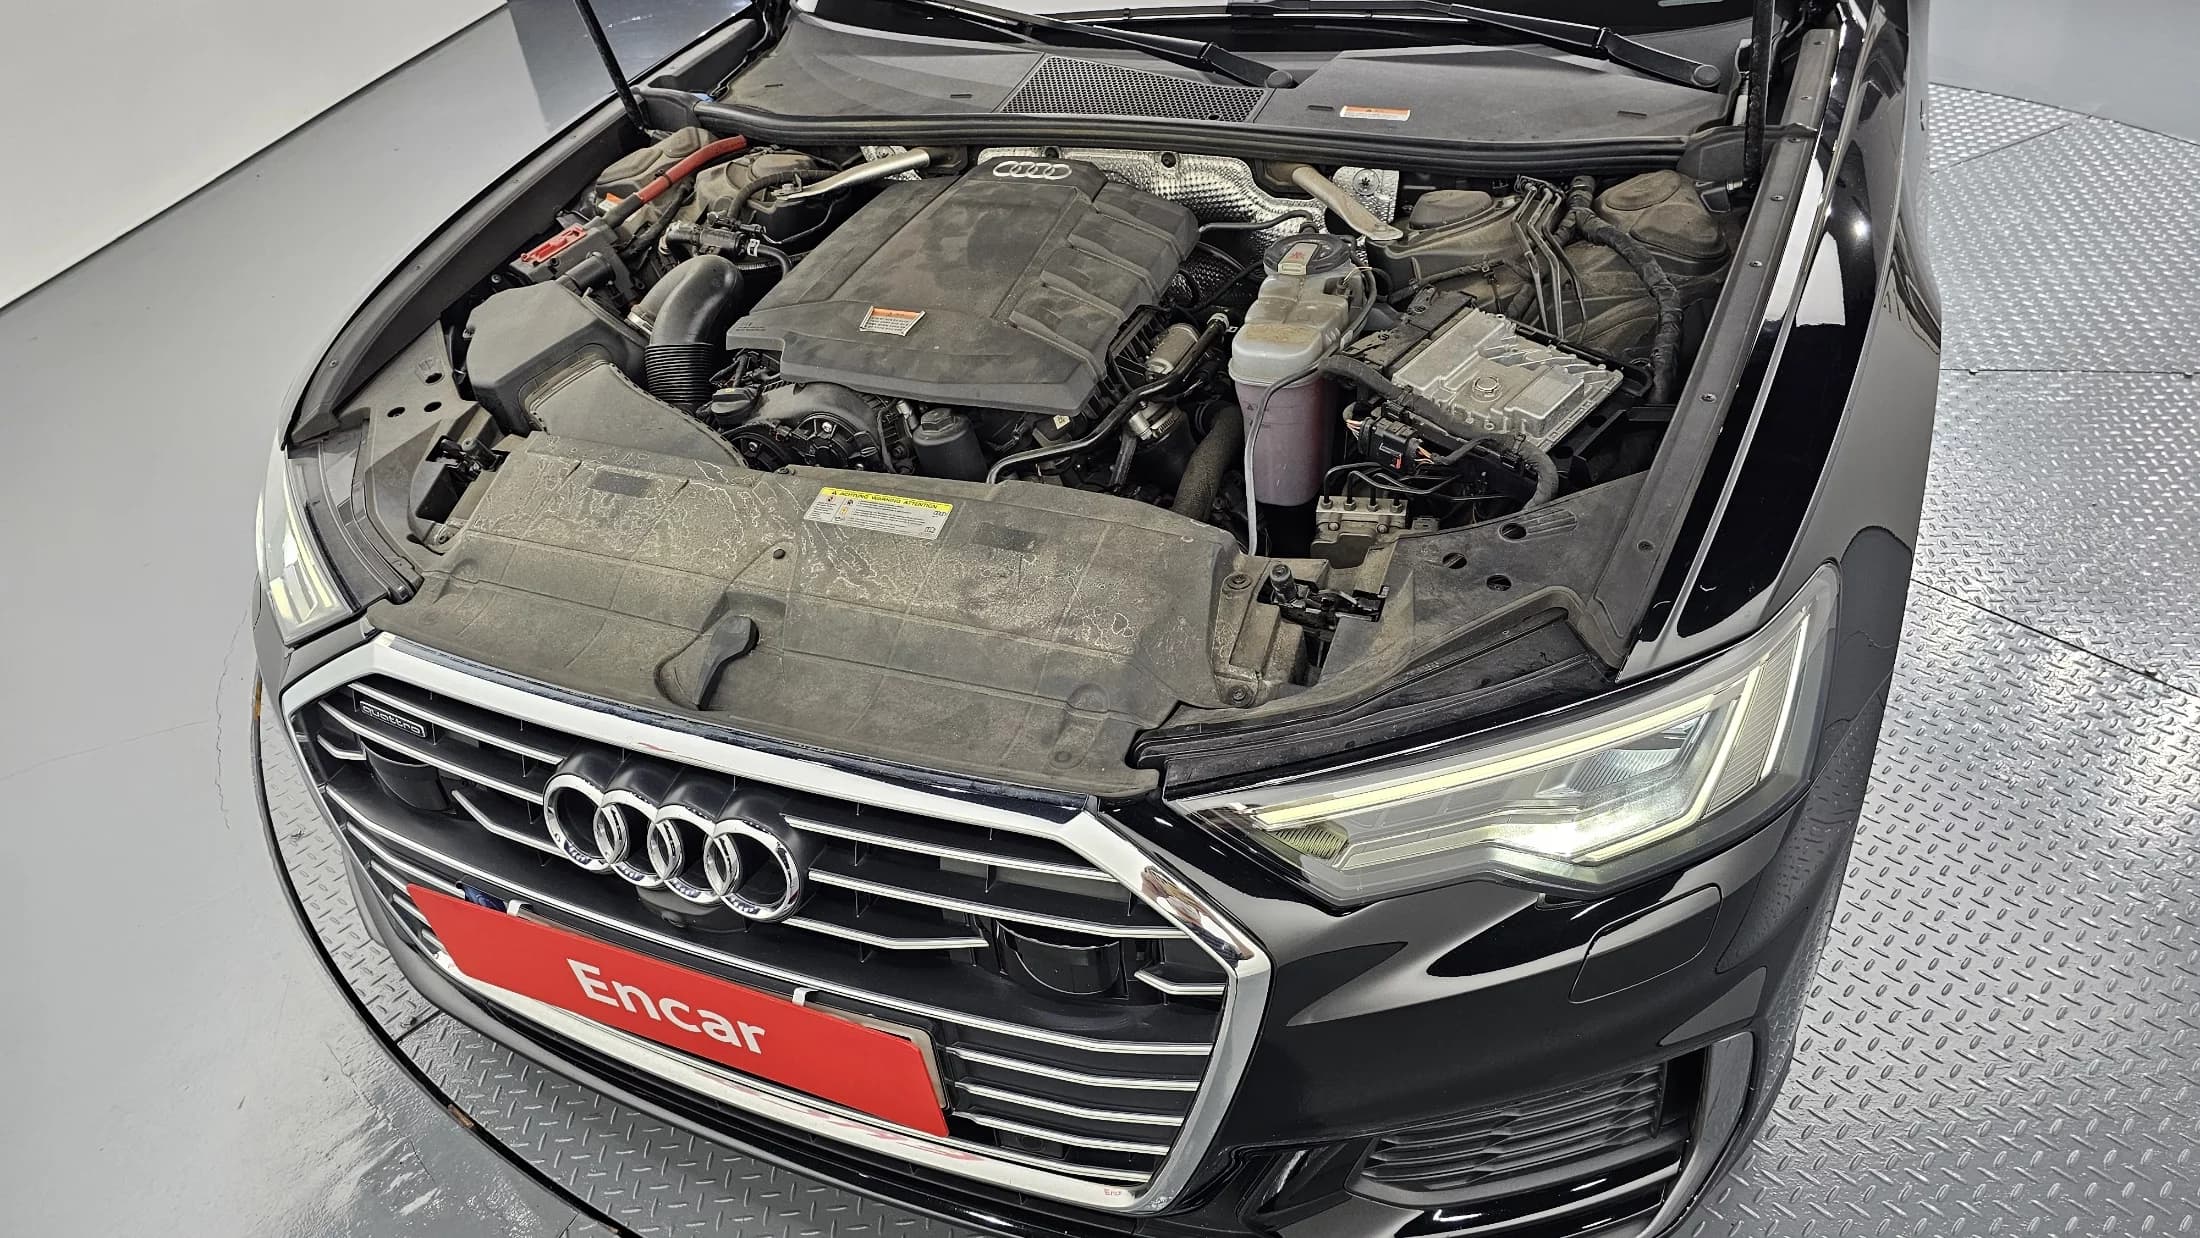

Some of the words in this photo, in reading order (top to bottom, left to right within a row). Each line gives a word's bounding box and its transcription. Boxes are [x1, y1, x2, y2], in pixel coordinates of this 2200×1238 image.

[903, 500, 938, 509] ATTENTION
[362, 704, 421, 734] quattro
[566, 957, 766, 1055] Encar
